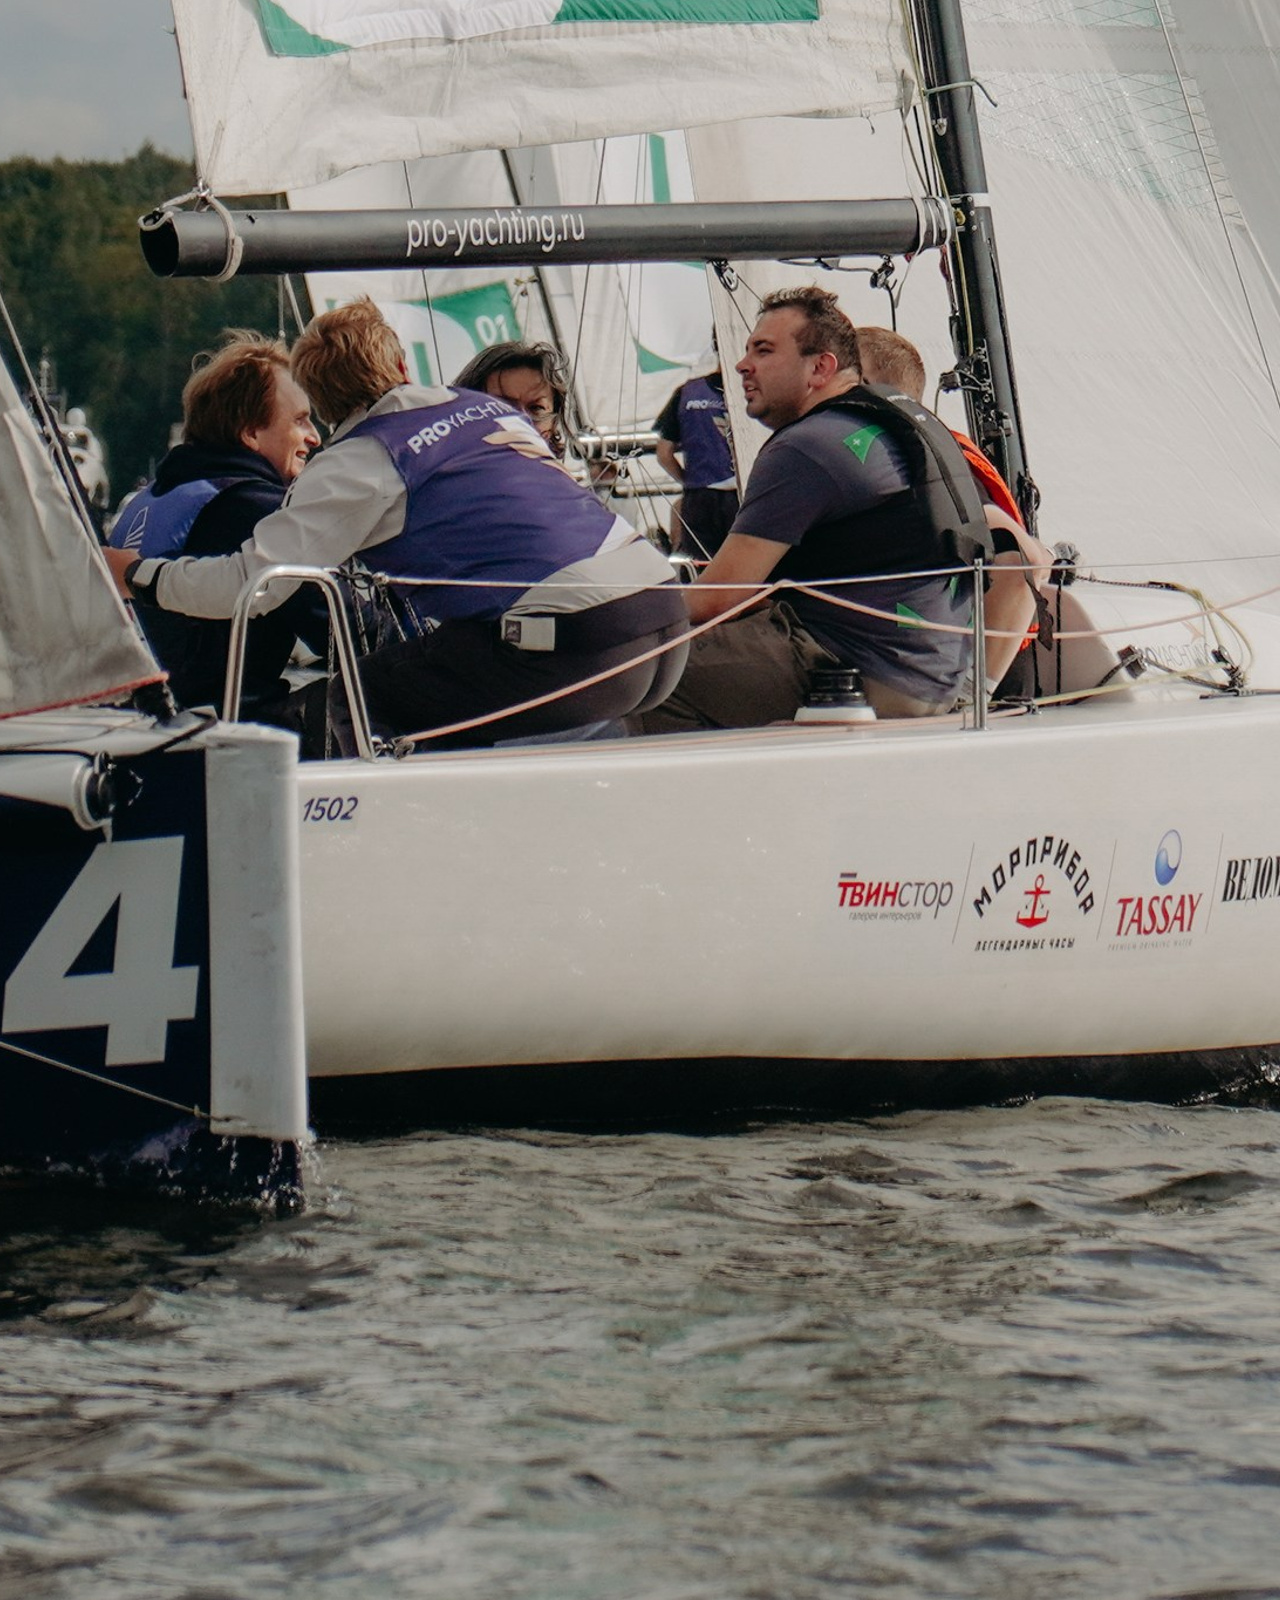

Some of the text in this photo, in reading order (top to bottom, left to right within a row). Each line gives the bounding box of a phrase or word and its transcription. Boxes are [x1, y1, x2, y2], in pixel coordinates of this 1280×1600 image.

[406, 208, 585, 257] pro-yachting.ru
[475, 314, 510, 347] 01
[303, 796, 359, 822] 1502
[973, 836, 1095, 919] МОРПРИБОР
[1115, 892, 1203, 937] TASSAY
[2, 835, 199, 1067] 4
[974, 937, 1075, 952] ЛЕГЕНДАРНЫЕ ЧАСЫ
